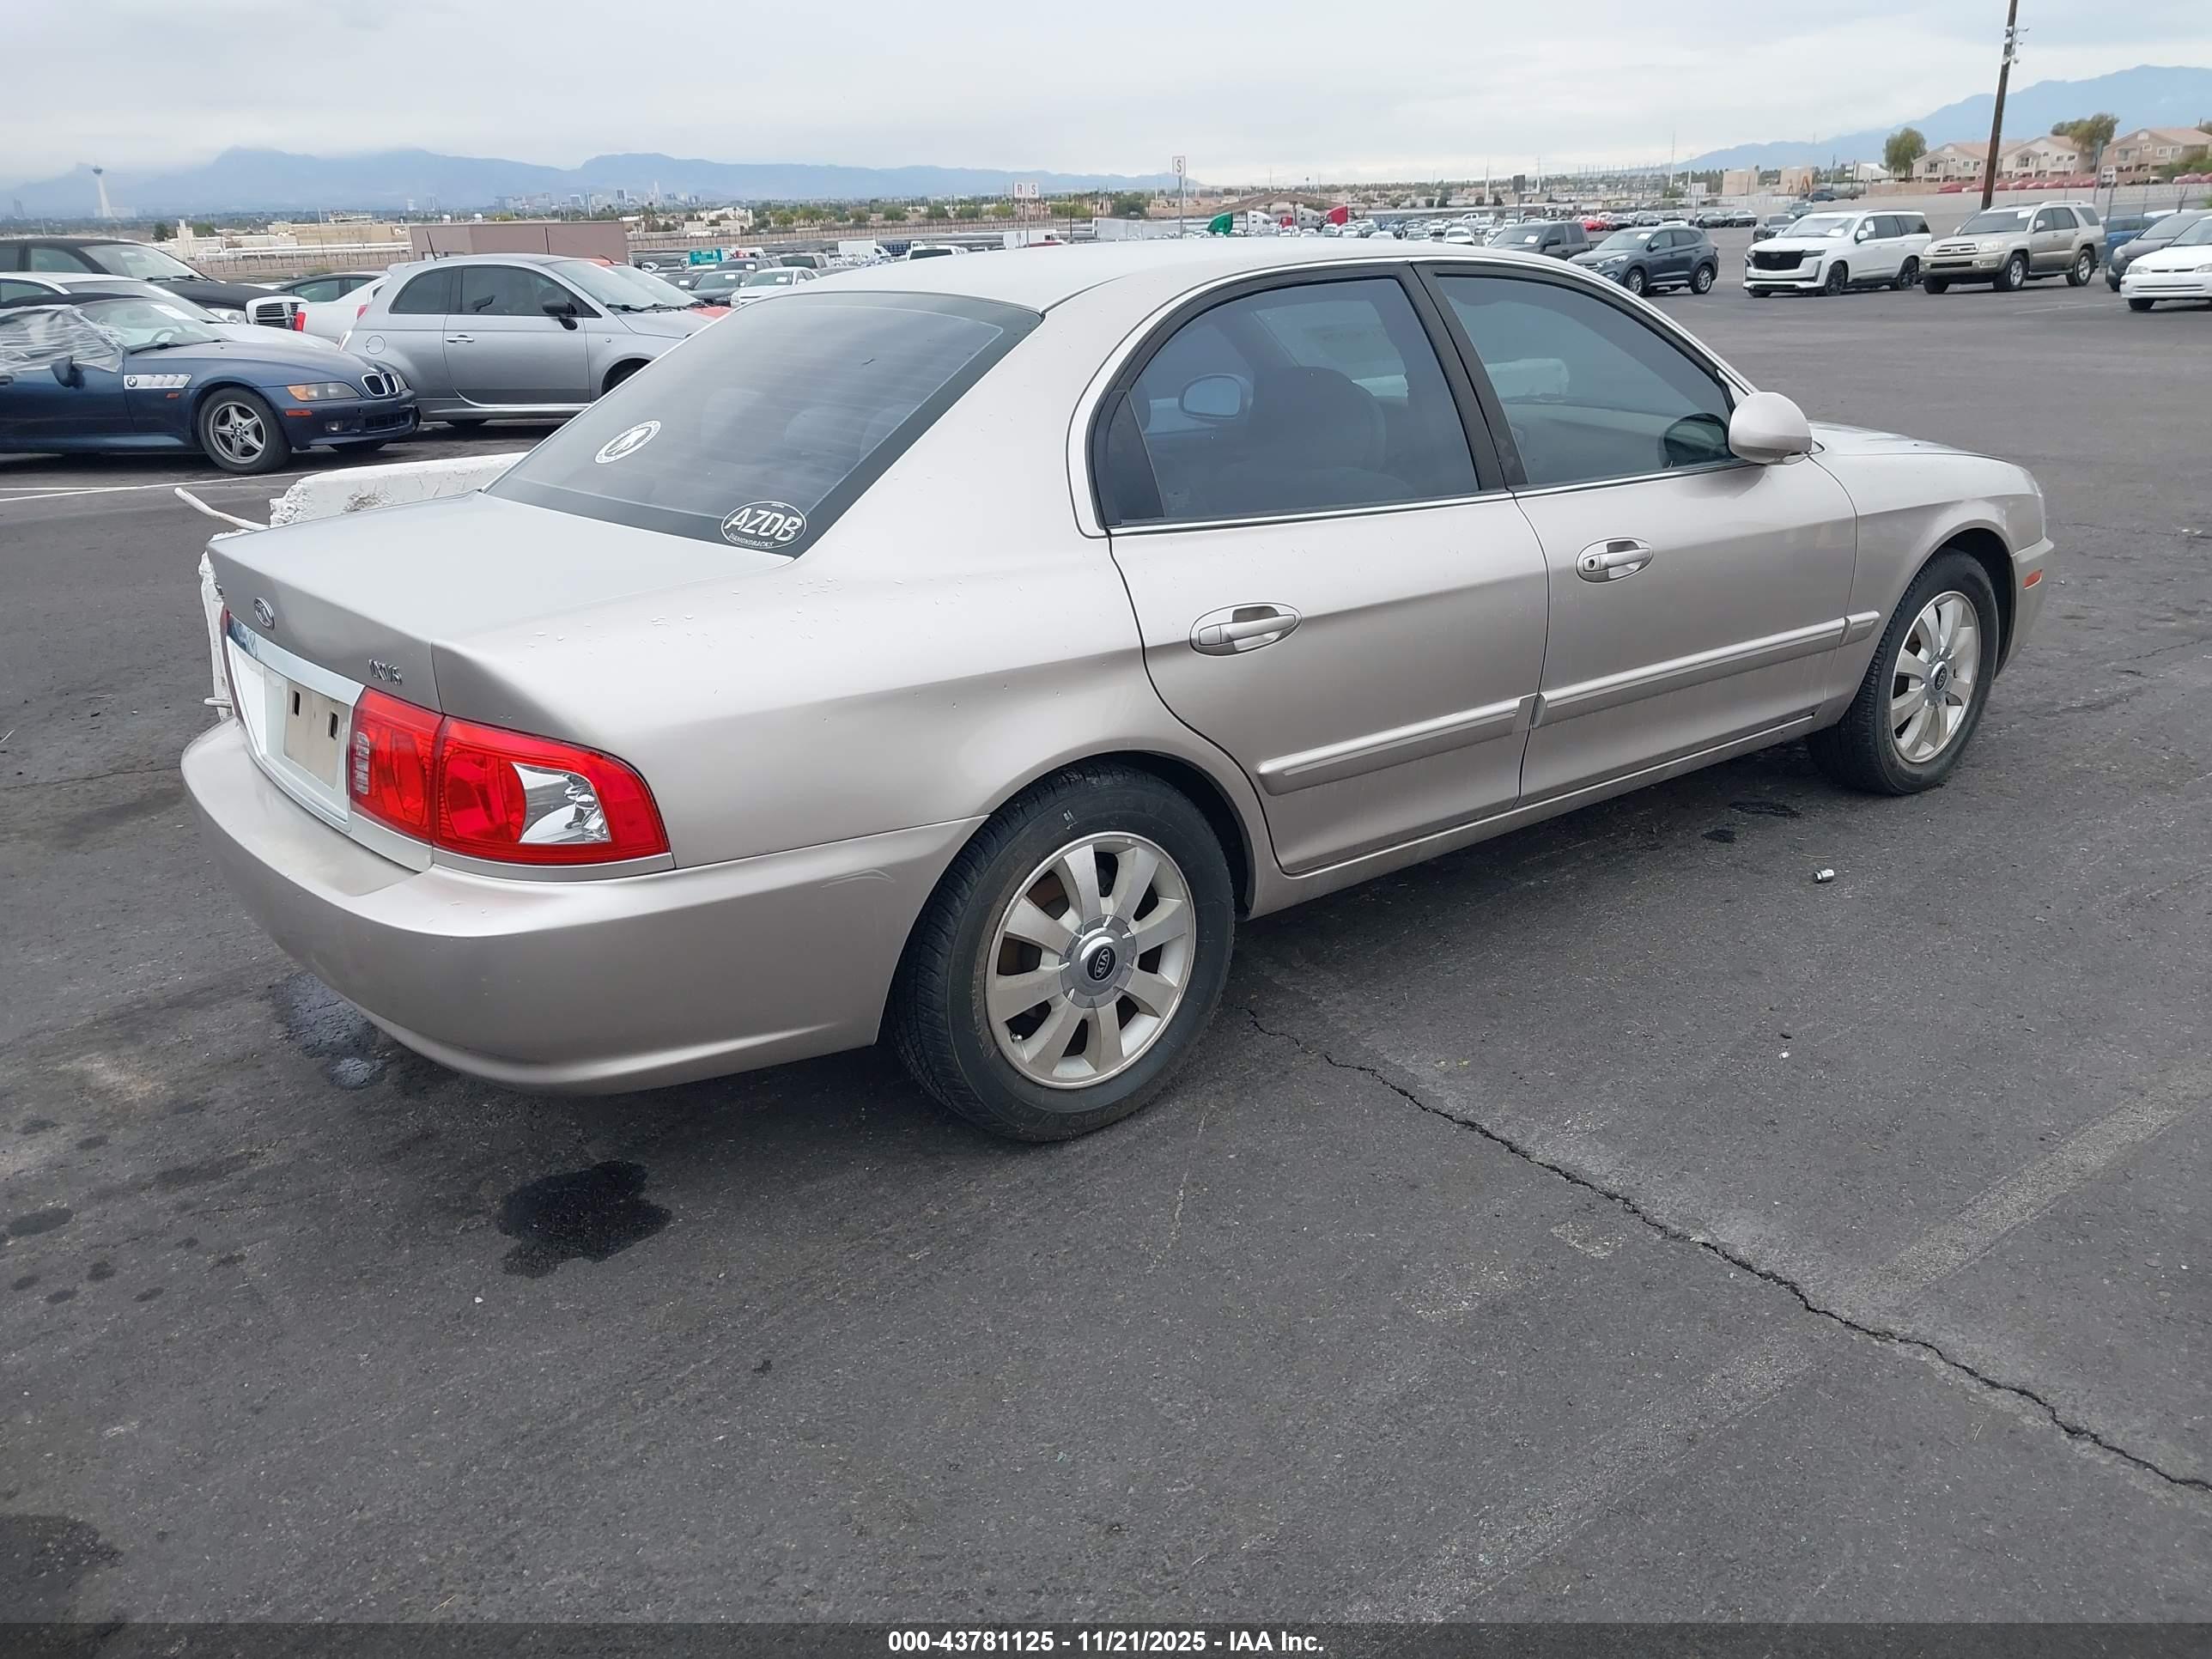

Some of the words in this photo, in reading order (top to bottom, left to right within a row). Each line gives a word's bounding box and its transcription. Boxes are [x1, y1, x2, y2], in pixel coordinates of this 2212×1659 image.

[1017, 184, 1024, 195] R
[1030, 185, 1036, 196] S
[724, 507, 803, 541] AZDB
[728, 532, 775, 547] DIAMONDBACKS
[1096, 954, 1109, 974] KIA
